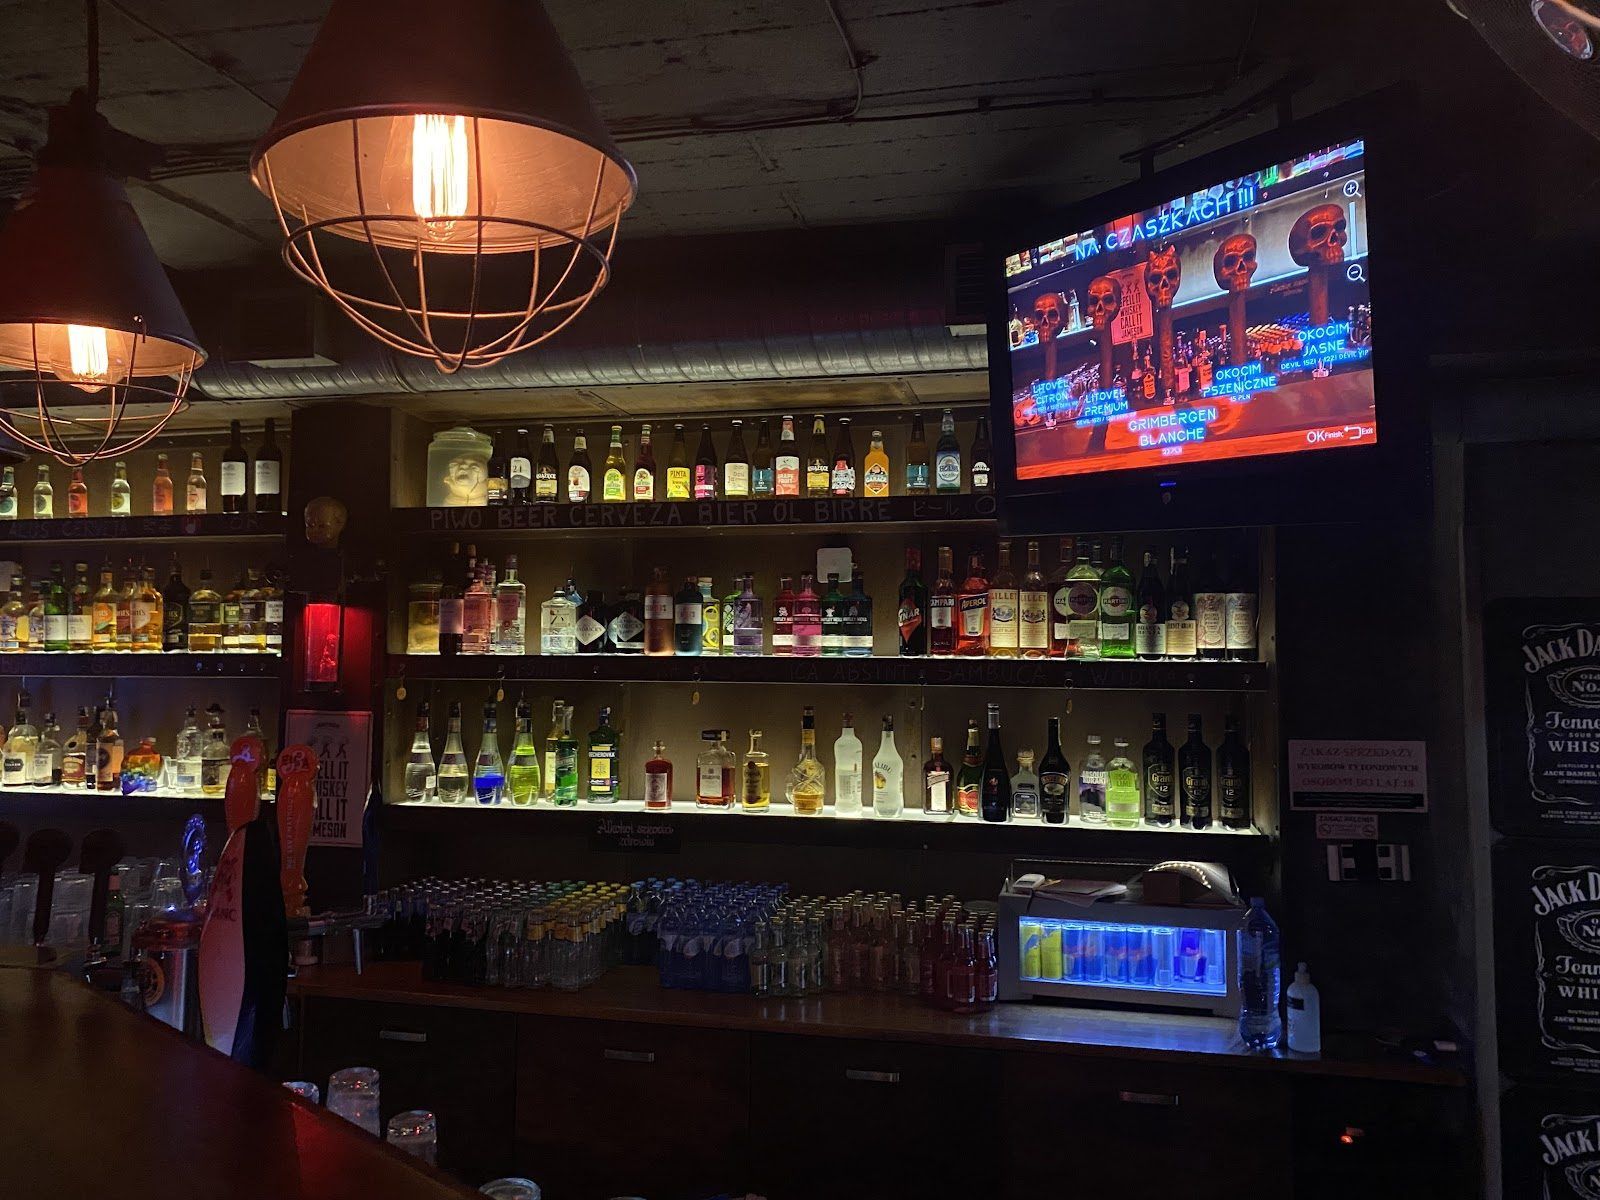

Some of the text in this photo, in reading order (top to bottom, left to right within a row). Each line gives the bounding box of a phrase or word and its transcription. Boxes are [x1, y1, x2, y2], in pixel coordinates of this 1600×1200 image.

[1074, 243, 1100, 261] NA
[1105, 192, 1235, 249] CZASZKACH
[1297, 321, 1350, 342] OKOCIM
[1302, 339, 1345, 357] JASNE
[1216, 363, 1262, 380] OKOCIM
[1085, 388, 1126, 404] LITOVEL
[1202, 376, 1277, 397] PSZENICZNE
[1084, 400, 1129, 416] PREMIUM
[1129, 408, 1217, 431] GRIMBERGEN
[1140, 427, 1205, 447] BLANCHE
[1307, 430, 1326, 443] OK
[430, 510, 482, 529] PIWO
[497, 506, 559, 528] BEER
[569, 504, 683, 526] CERVEZA
[698, 501, 758, 524] BIER
[815, 499, 893, 522] BIRRE
[961, 597, 986, 609] APEROL
[1521, 635, 1576, 674] JACK
[338, 761, 349, 780] IT
[336, 799, 348, 821] IT
[312, 821, 348, 838] MESON
[1530, 879, 1587, 916] JACK
[1540, 1129, 1596, 1165] JACK
